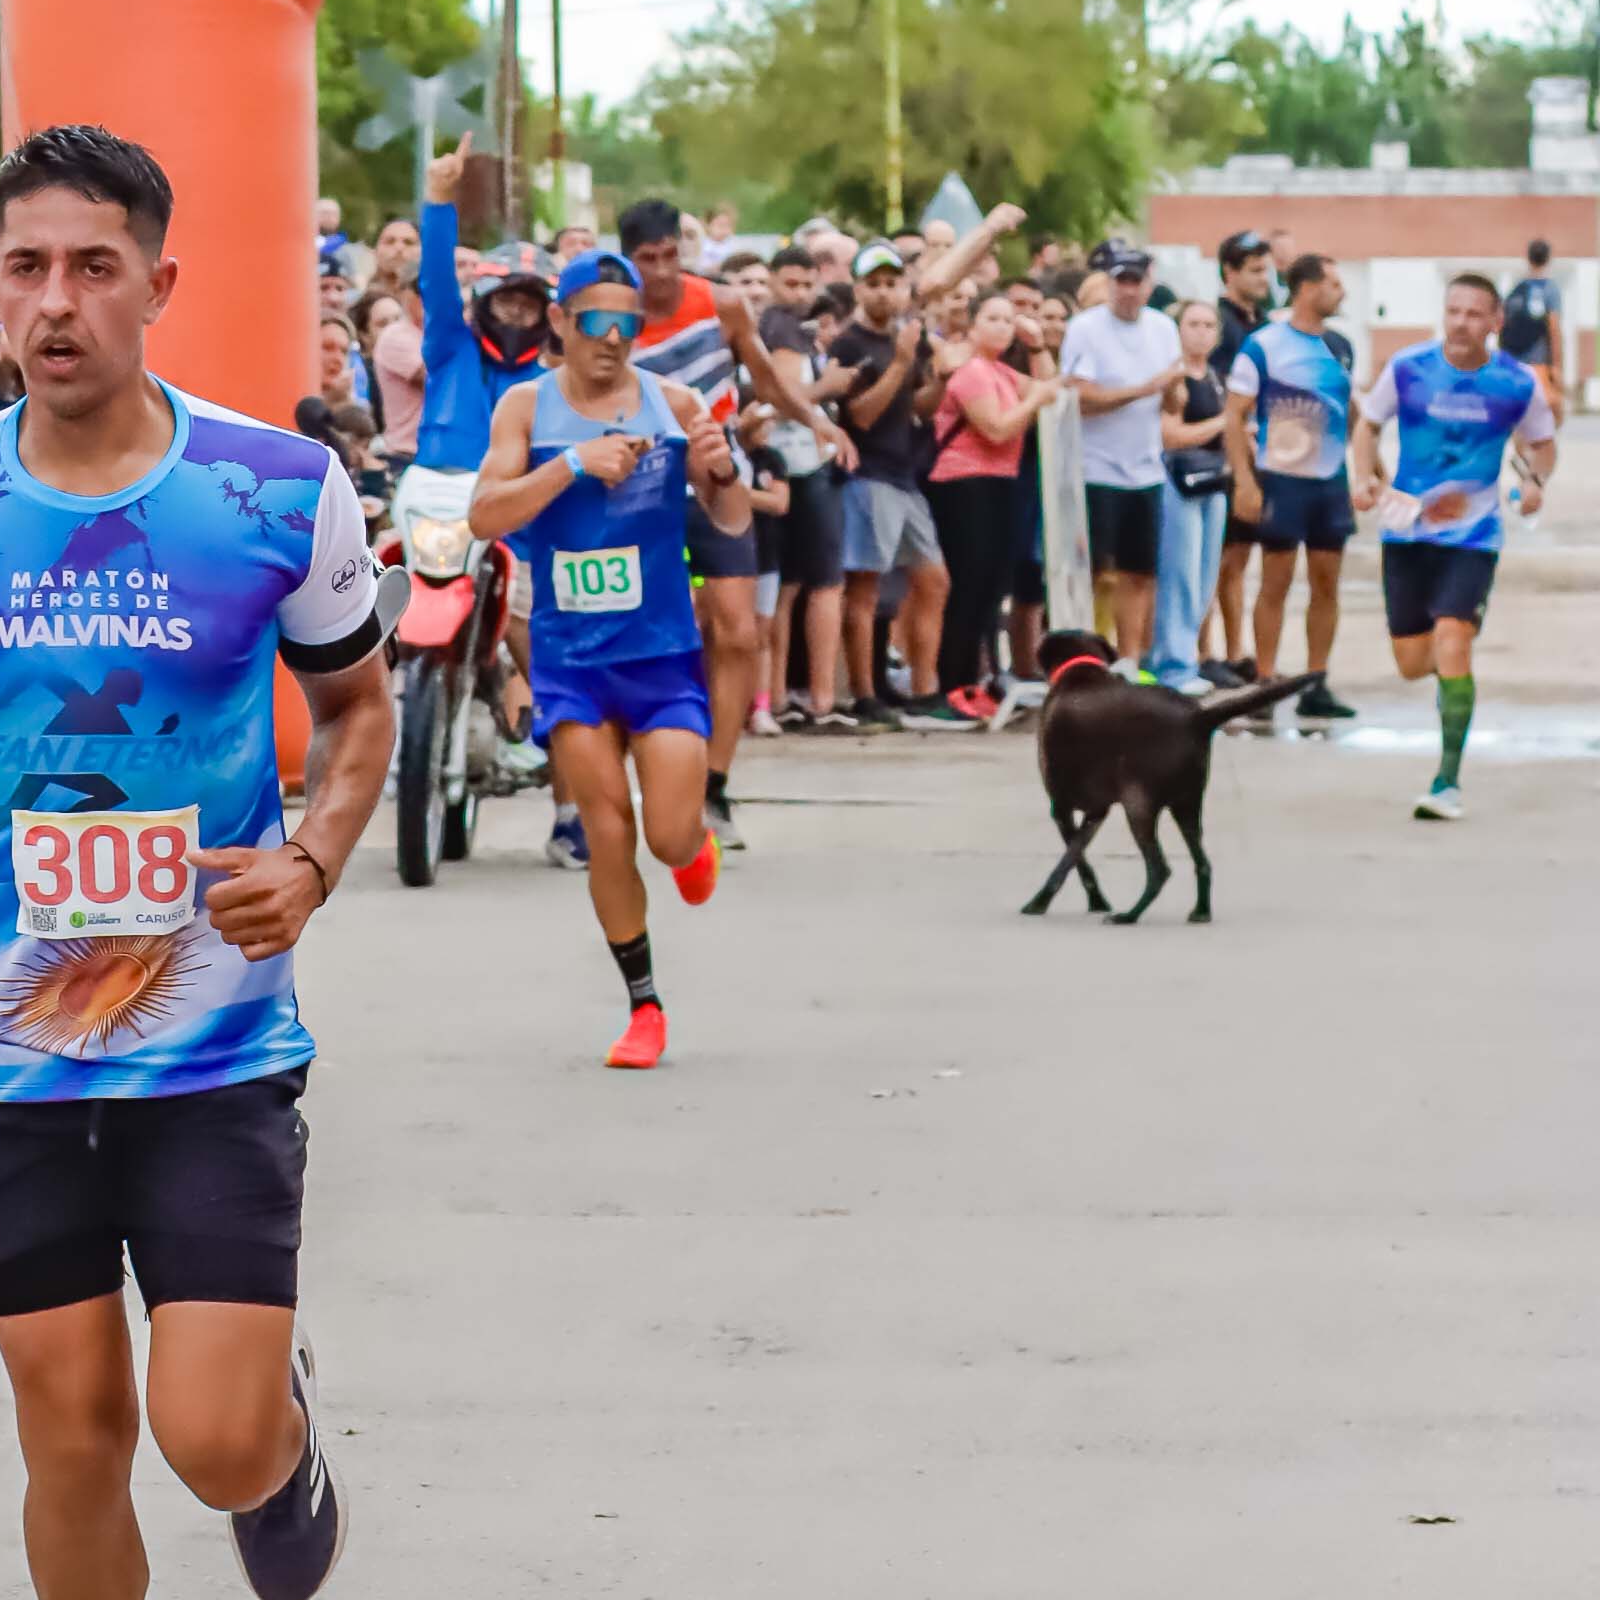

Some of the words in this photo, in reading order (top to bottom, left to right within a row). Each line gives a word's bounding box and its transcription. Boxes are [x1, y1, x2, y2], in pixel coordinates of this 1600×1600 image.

[10, 567, 169, 590] MARATÓN
[563, 556, 631, 596] 103
[10, 590, 120, 609] HÉROES
[135, 594, 169, 610] DE
[23, 824, 188, 906] 308
[135, 909, 186, 924] CARUSO
